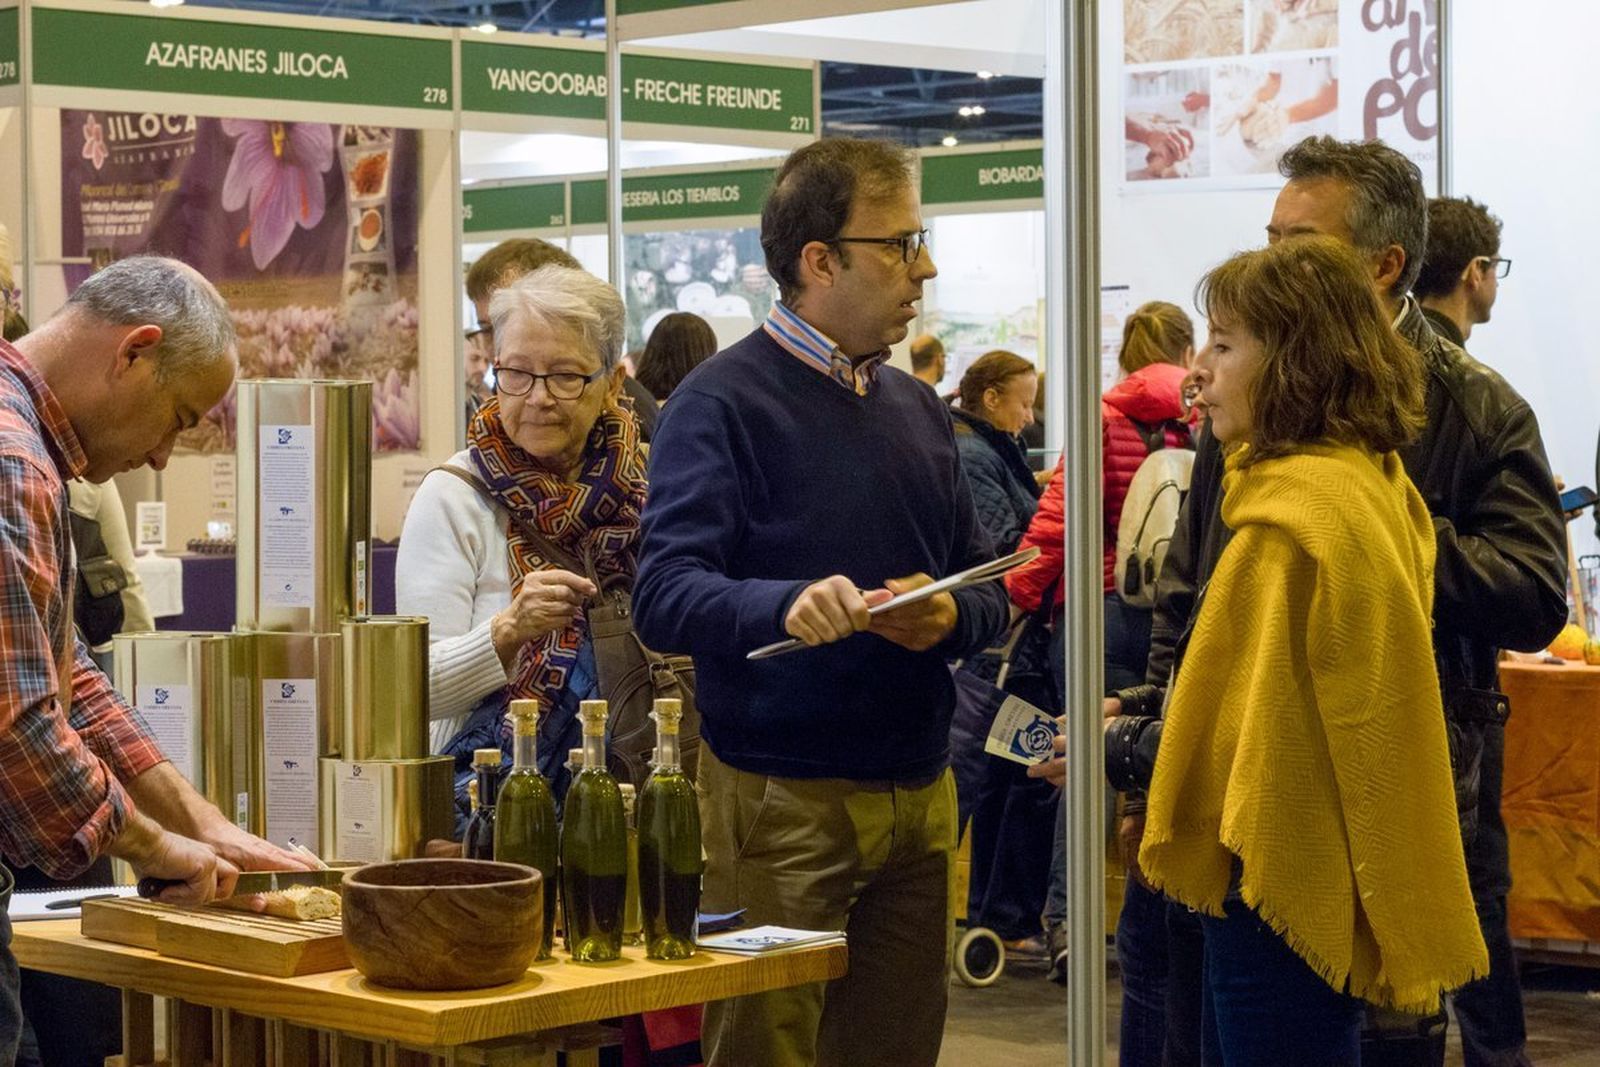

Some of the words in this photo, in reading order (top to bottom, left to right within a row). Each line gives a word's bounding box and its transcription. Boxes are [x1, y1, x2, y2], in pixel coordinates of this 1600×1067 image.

[145, 42, 268, 75] AZAFRANES
[273, 54, 349, 79] JILOCA
[423, 87, 448, 104] 278
[487, 68, 607, 97] YANGOOBAB
[635, 78, 702, 105] FRECHE
[706, 85, 782, 112] FREUNDE
[108, 112, 197, 142] JILOCA
[790, 116, 810, 131] 271
[622, 190, 660, 207] ESERIA
[662, 188, 684, 205] LOS
[686, 184, 740, 204] TIEMBLOS
